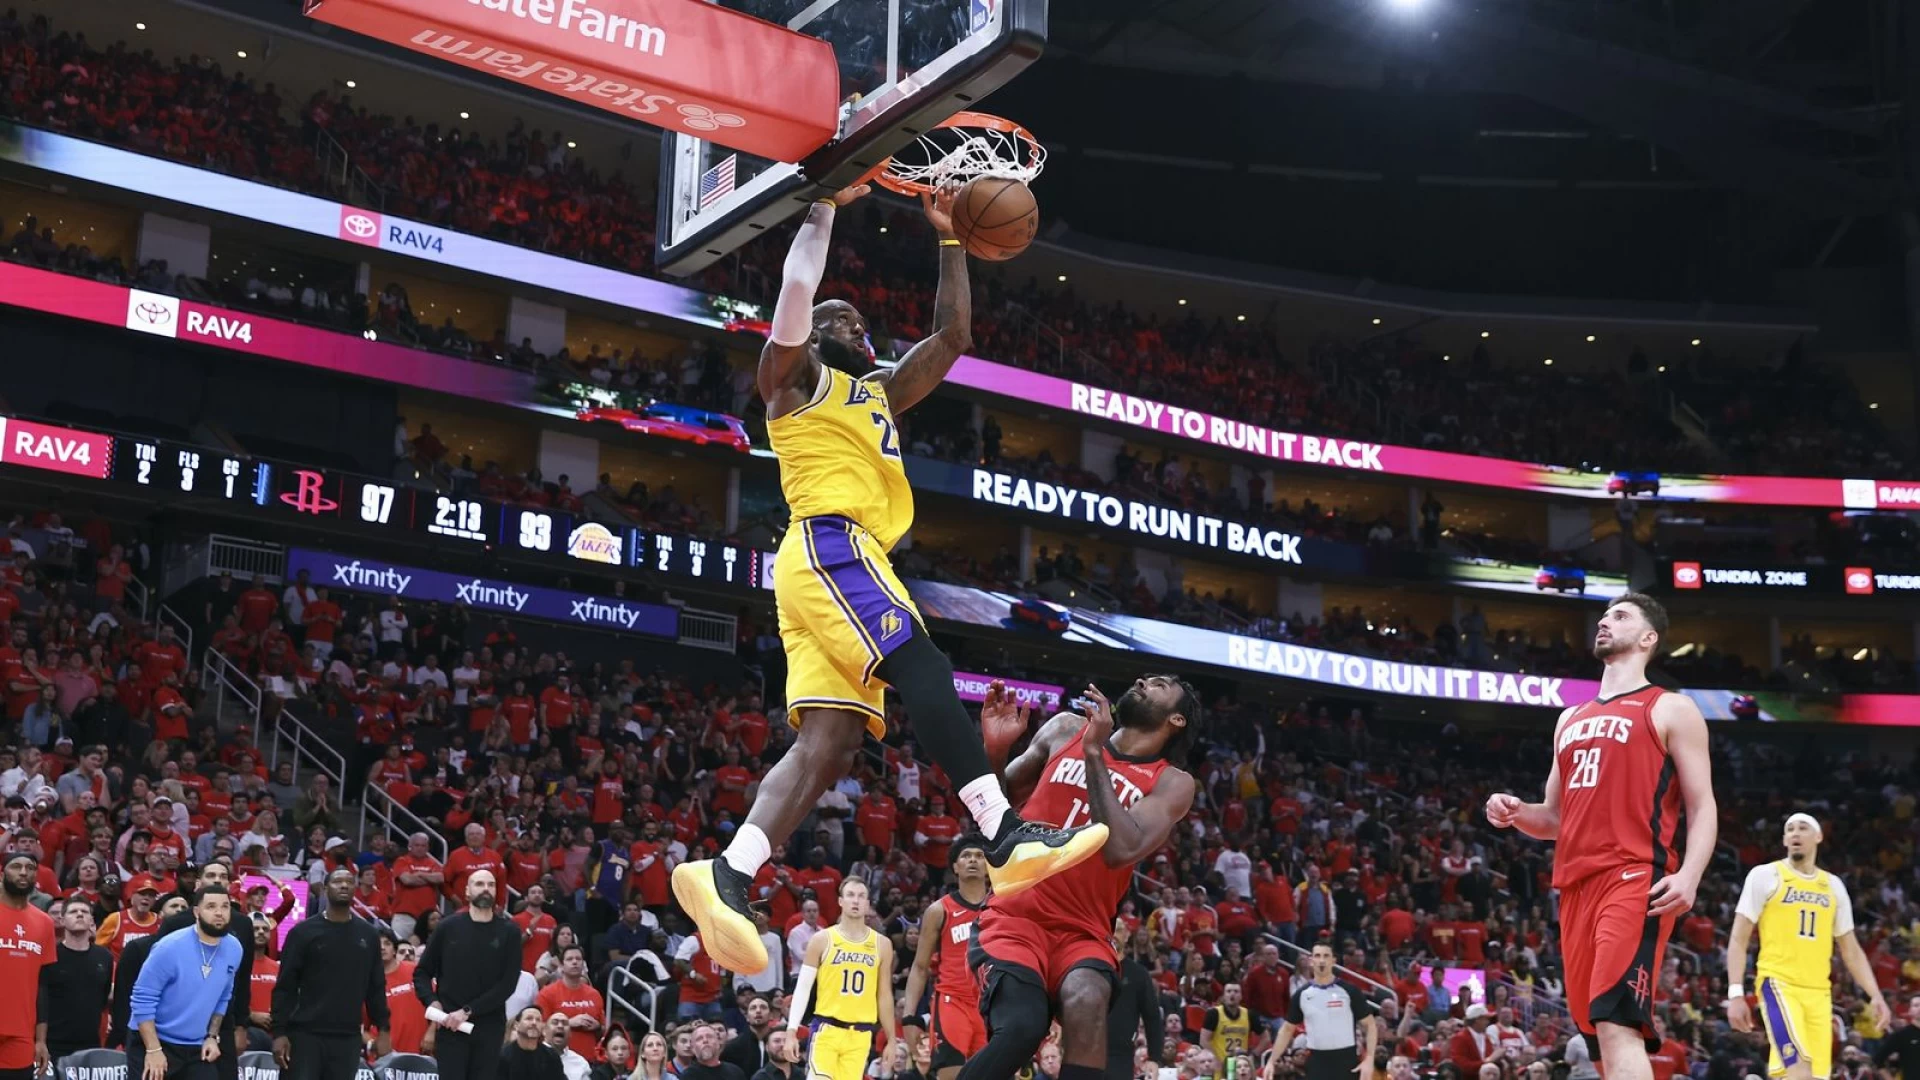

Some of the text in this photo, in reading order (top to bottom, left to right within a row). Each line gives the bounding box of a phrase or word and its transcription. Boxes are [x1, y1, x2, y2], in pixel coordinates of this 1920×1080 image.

[390, 226, 443, 253] RAV4
[187, 311, 252, 343] RAV4
[870, 411, 901, 458] 2
[1073, 384, 1382, 469] READY TO RUN IT BACK
[15, 431, 91, 465] RAV4
[136, 443, 156, 462] TOL
[138, 460, 152, 484] 2
[181, 467, 194, 491] 3
[225, 475, 234, 498] 1
[361, 483, 395, 524] 97
[435, 497, 482, 532] 2:13
[973, 469, 1301, 564] READY TO RUN IT BACK
[519, 511, 552, 551] 93
[659, 550, 669, 571] 2
[726, 561, 733, 582] 1
[333, 561, 411, 594] xfinity
[1703, 569, 1807, 586] TUNDRA ZONE
[1875, 574, 1920, 589] TUNDR
[456, 580, 529, 611] xfinity
[571, 598, 640, 628] xfinity
[1228, 636, 1563, 706] READY TO RUN IT BACK
[1559, 715, 1632, 754] ROCKETS
[1568, 747, 1601, 789] 28
[1799, 909, 1815, 938] 11
[832, 949, 875, 967] LAKERS
[841, 969, 865, 994] 10
[79, 1064, 128, 1080] PLAYOFF
